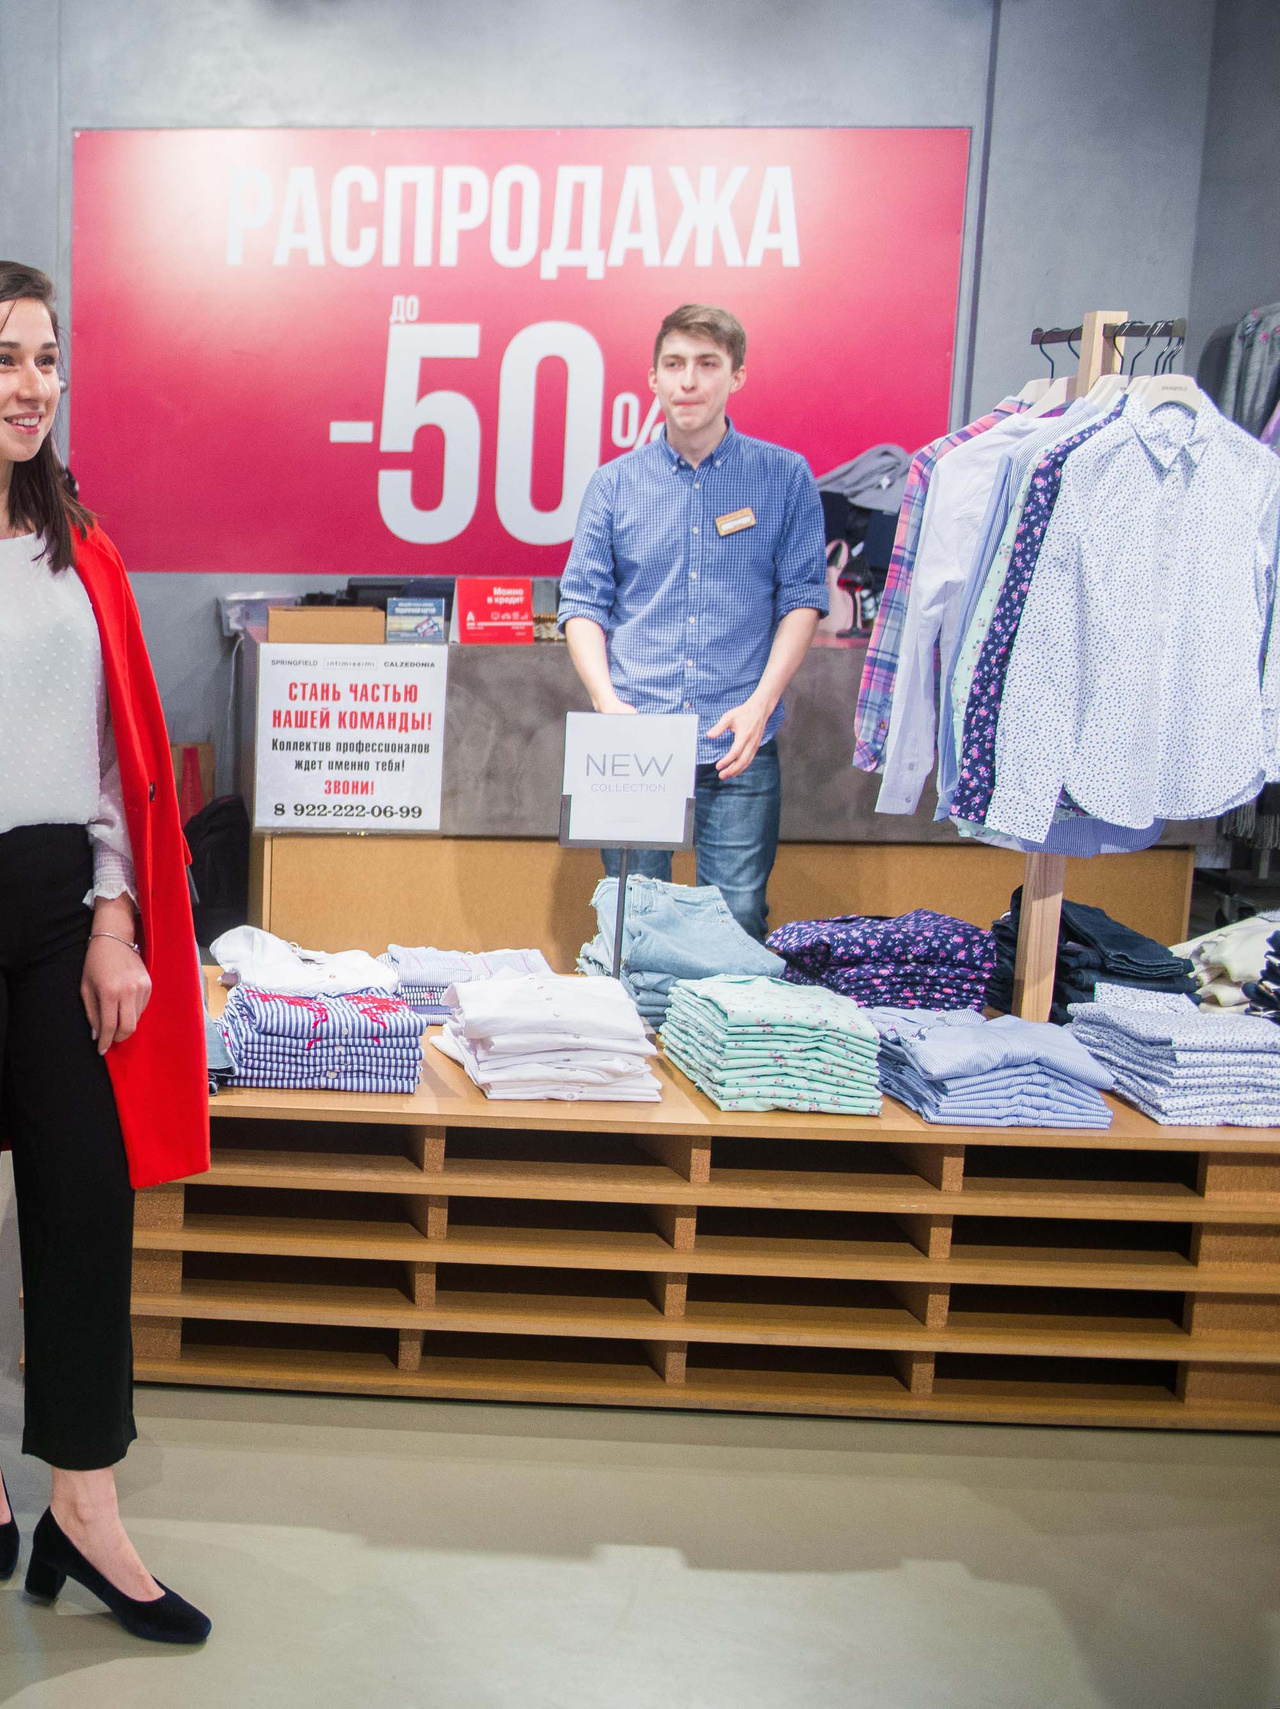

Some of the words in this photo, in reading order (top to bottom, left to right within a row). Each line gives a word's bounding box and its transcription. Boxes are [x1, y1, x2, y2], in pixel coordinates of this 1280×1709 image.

[226, 165, 800, 280] РАСПРОДАЖА
[271, 659, 318, 667] SPRINGFIELD
[288, 681, 341, 701] СТАНЬ
[349, 683, 418, 703] ЧАСТЬЮ
[272, 707, 330, 729] НАШЕЙ
[338, 710, 432, 733] КОМАНДЫ!
[272, 738, 331, 752] Коллектив
[336, 740, 430, 754] профессионалов
[294, 759, 323, 772] ждет
[328, 760, 370, 771] именно
[376, 759, 405, 772] тебя!
[586, 753, 673, 777] NEW
[324, 779, 375, 795] ЗВОНИ!
[591, 783, 666, 793] COLLECTION
[274, 803, 285, 816] 8
[293, 803, 423, 818] 922-222-06-99
